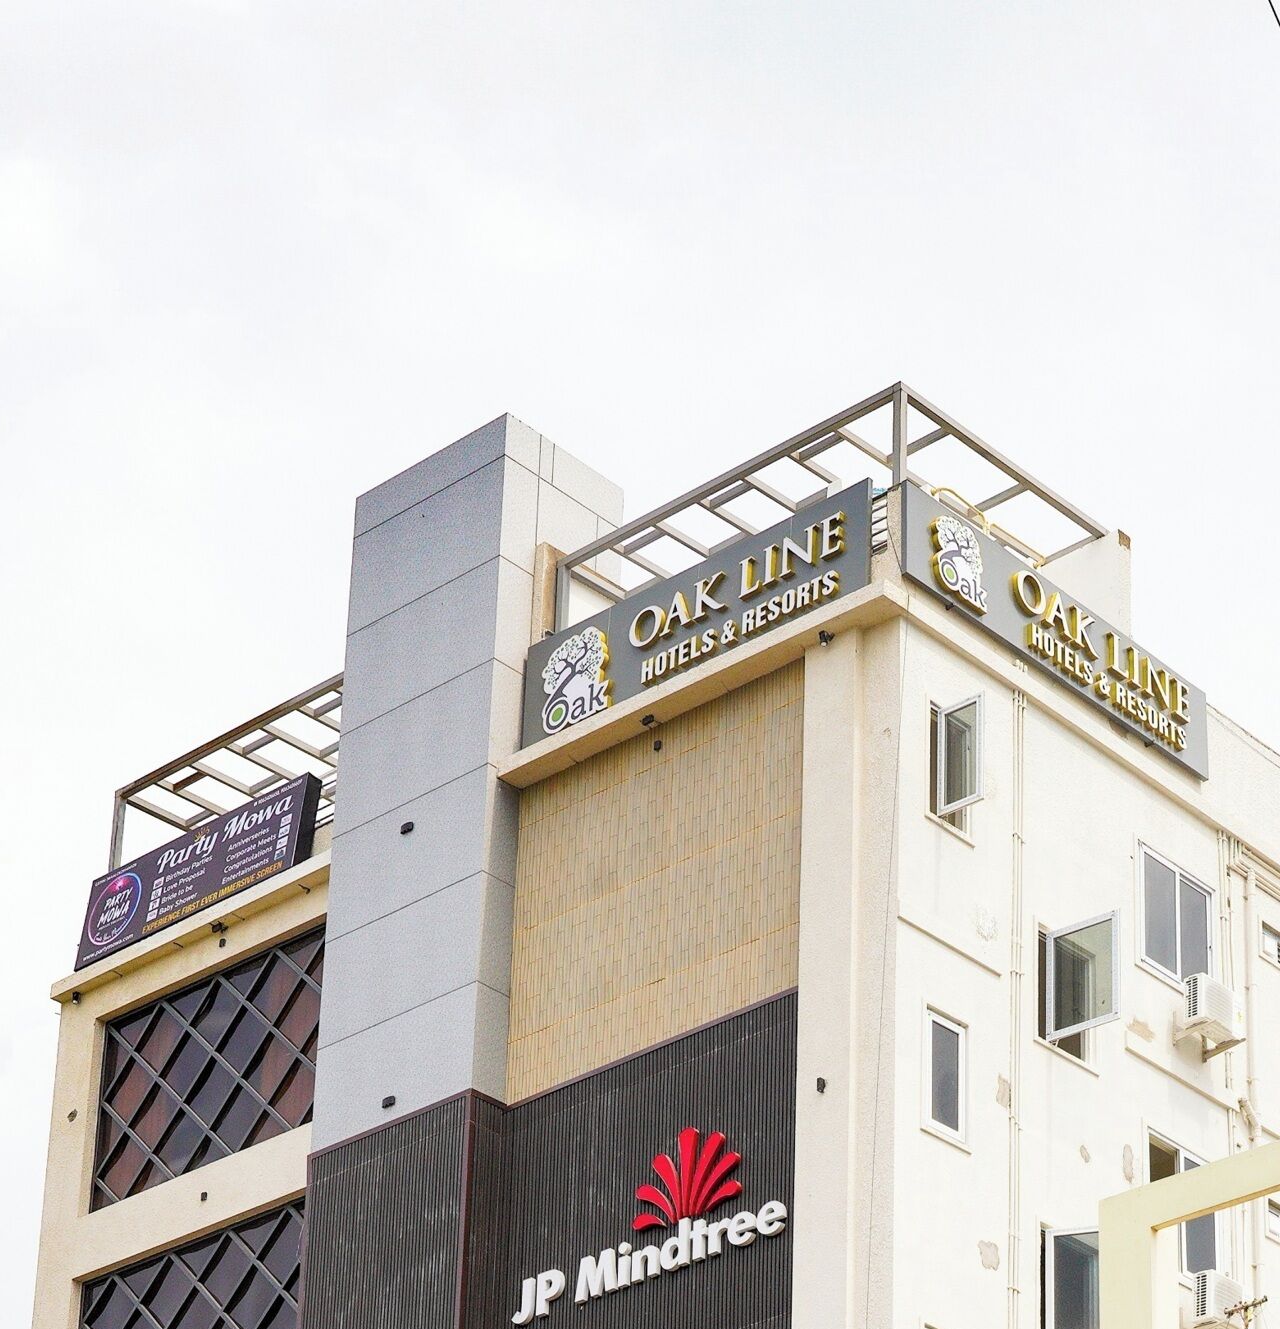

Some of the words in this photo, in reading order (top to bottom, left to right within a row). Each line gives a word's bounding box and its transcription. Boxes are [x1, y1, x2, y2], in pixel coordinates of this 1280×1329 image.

[628, 570, 728, 648] OAK
[738, 510, 846, 600] LINE
[940, 558, 986, 608] Oak
[640, 627, 719, 685] HOTELS
[720, 619, 740, 646] &
[741, 569, 840, 637] RESORTS
[1014, 570, 1099, 661] OAK
[1106, 631, 1190, 725] LINE
[1027, 623, 1094, 685] HOTELS
[1094, 672, 1111, 699] &
[1113, 681, 1187, 752] RESORTS
[545, 682, 606, 732] Oak
[157, 831, 219, 873] Party
[222, 795, 294, 843] Mowa
[225, 844, 257, 862] Corporate
[257, 833, 277, 848] Meets
[165, 866, 191, 883] Birthday
[191, 855, 213, 870] Parties
[221, 857, 269, 885] Entertainments
[223, 846, 273, 873] Congratulations
[163, 882, 178, 893] Love
[178, 868, 206, 885] Proposal
[104, 887, 133, 910] PARTY
[142, 910, 181, 934] EXPERIENCE
[181, 900, 200, 914] FIRST
[200, 892, 218, 906] EVER
[218, 876, 256, 898] IMMERSIVE
[256, 861, 284, 881] SCREEN
[159, 903, 174, 915] Baby
[175, 892, 198, 907] Shower
[161, 892, 177, 904] Bride
[97, 900, 130, 928] MOWA
[82, 934, 134, 961] www.partymowa.com
[511, 1269, 566, 1326] JP
[574, 1200, 788, 1305] Mindtree
